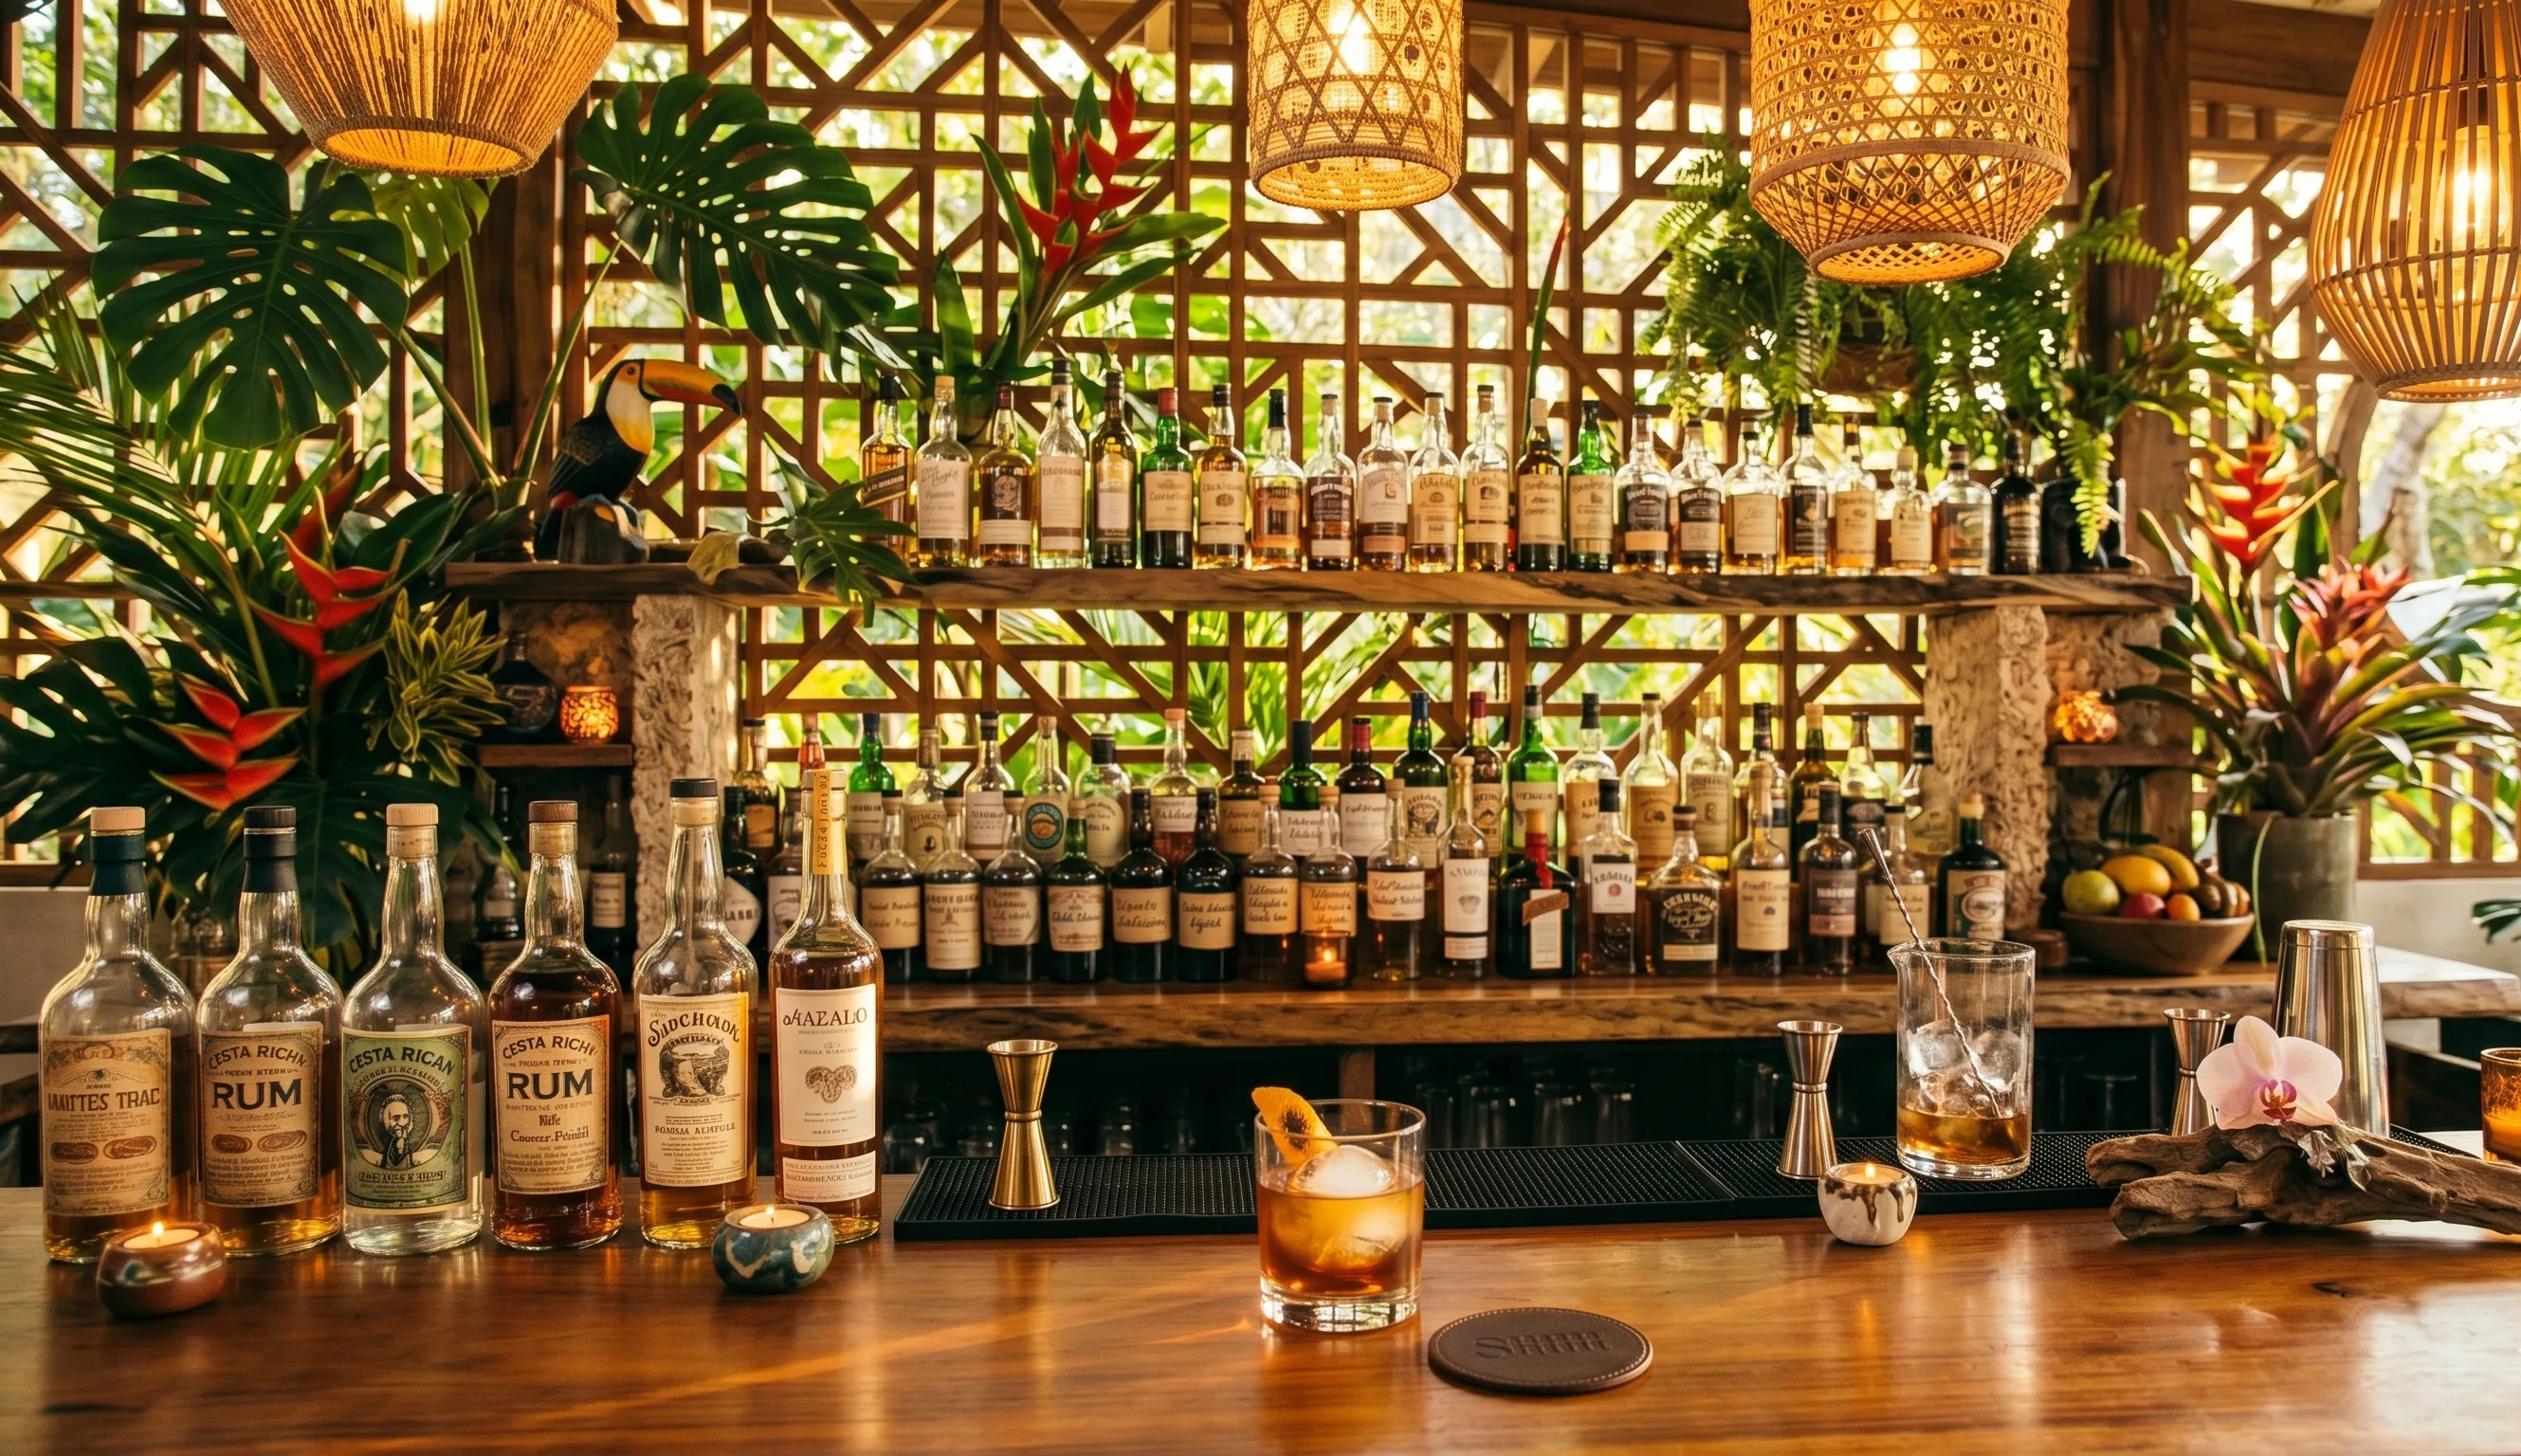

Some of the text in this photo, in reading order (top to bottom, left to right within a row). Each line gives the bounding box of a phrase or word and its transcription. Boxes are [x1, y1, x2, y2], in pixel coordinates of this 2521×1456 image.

[209, 1046, 251, 1069] CESTA
[349, 1046, 455, 1076] CESTA RICAN
[502, 1036, 546, 1059] CESTA
[211, 1078, 302, 1110] RUM
[506, 1068, 594, 1100] RUM
